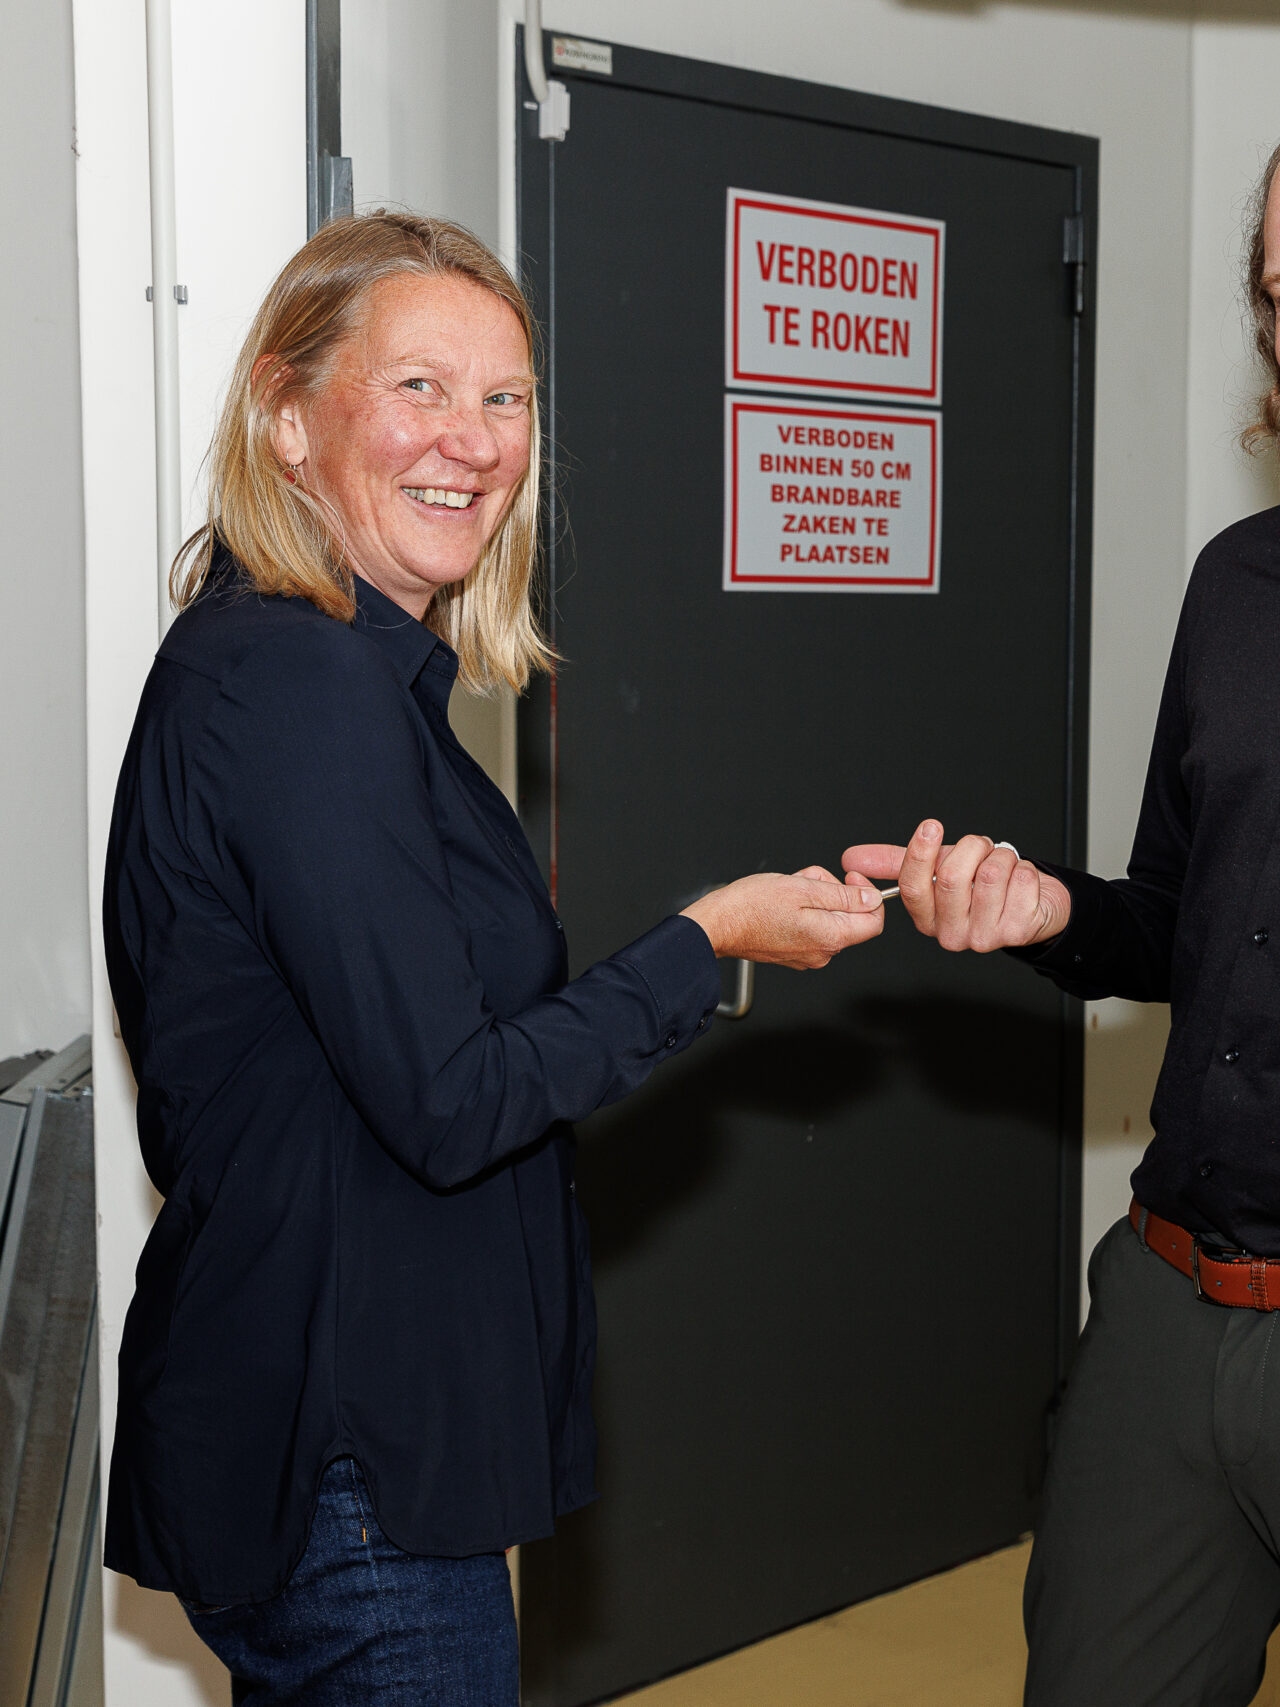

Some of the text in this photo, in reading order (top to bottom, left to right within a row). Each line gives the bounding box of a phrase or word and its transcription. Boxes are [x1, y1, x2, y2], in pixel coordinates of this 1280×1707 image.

[756, 240, 918, 300] VERBODEN
[763, 304, 910, 358] TE ROKEN
[777, 425, 894, 451] VERBODEN
[759, 453, 911, 481] BINNEN 50 CM
[770, 484, 901, 509] BRANDBARE
[782, 513, 889, 537] ZAKEN TE
[780, 543, 890, 566] PLAATSEN
